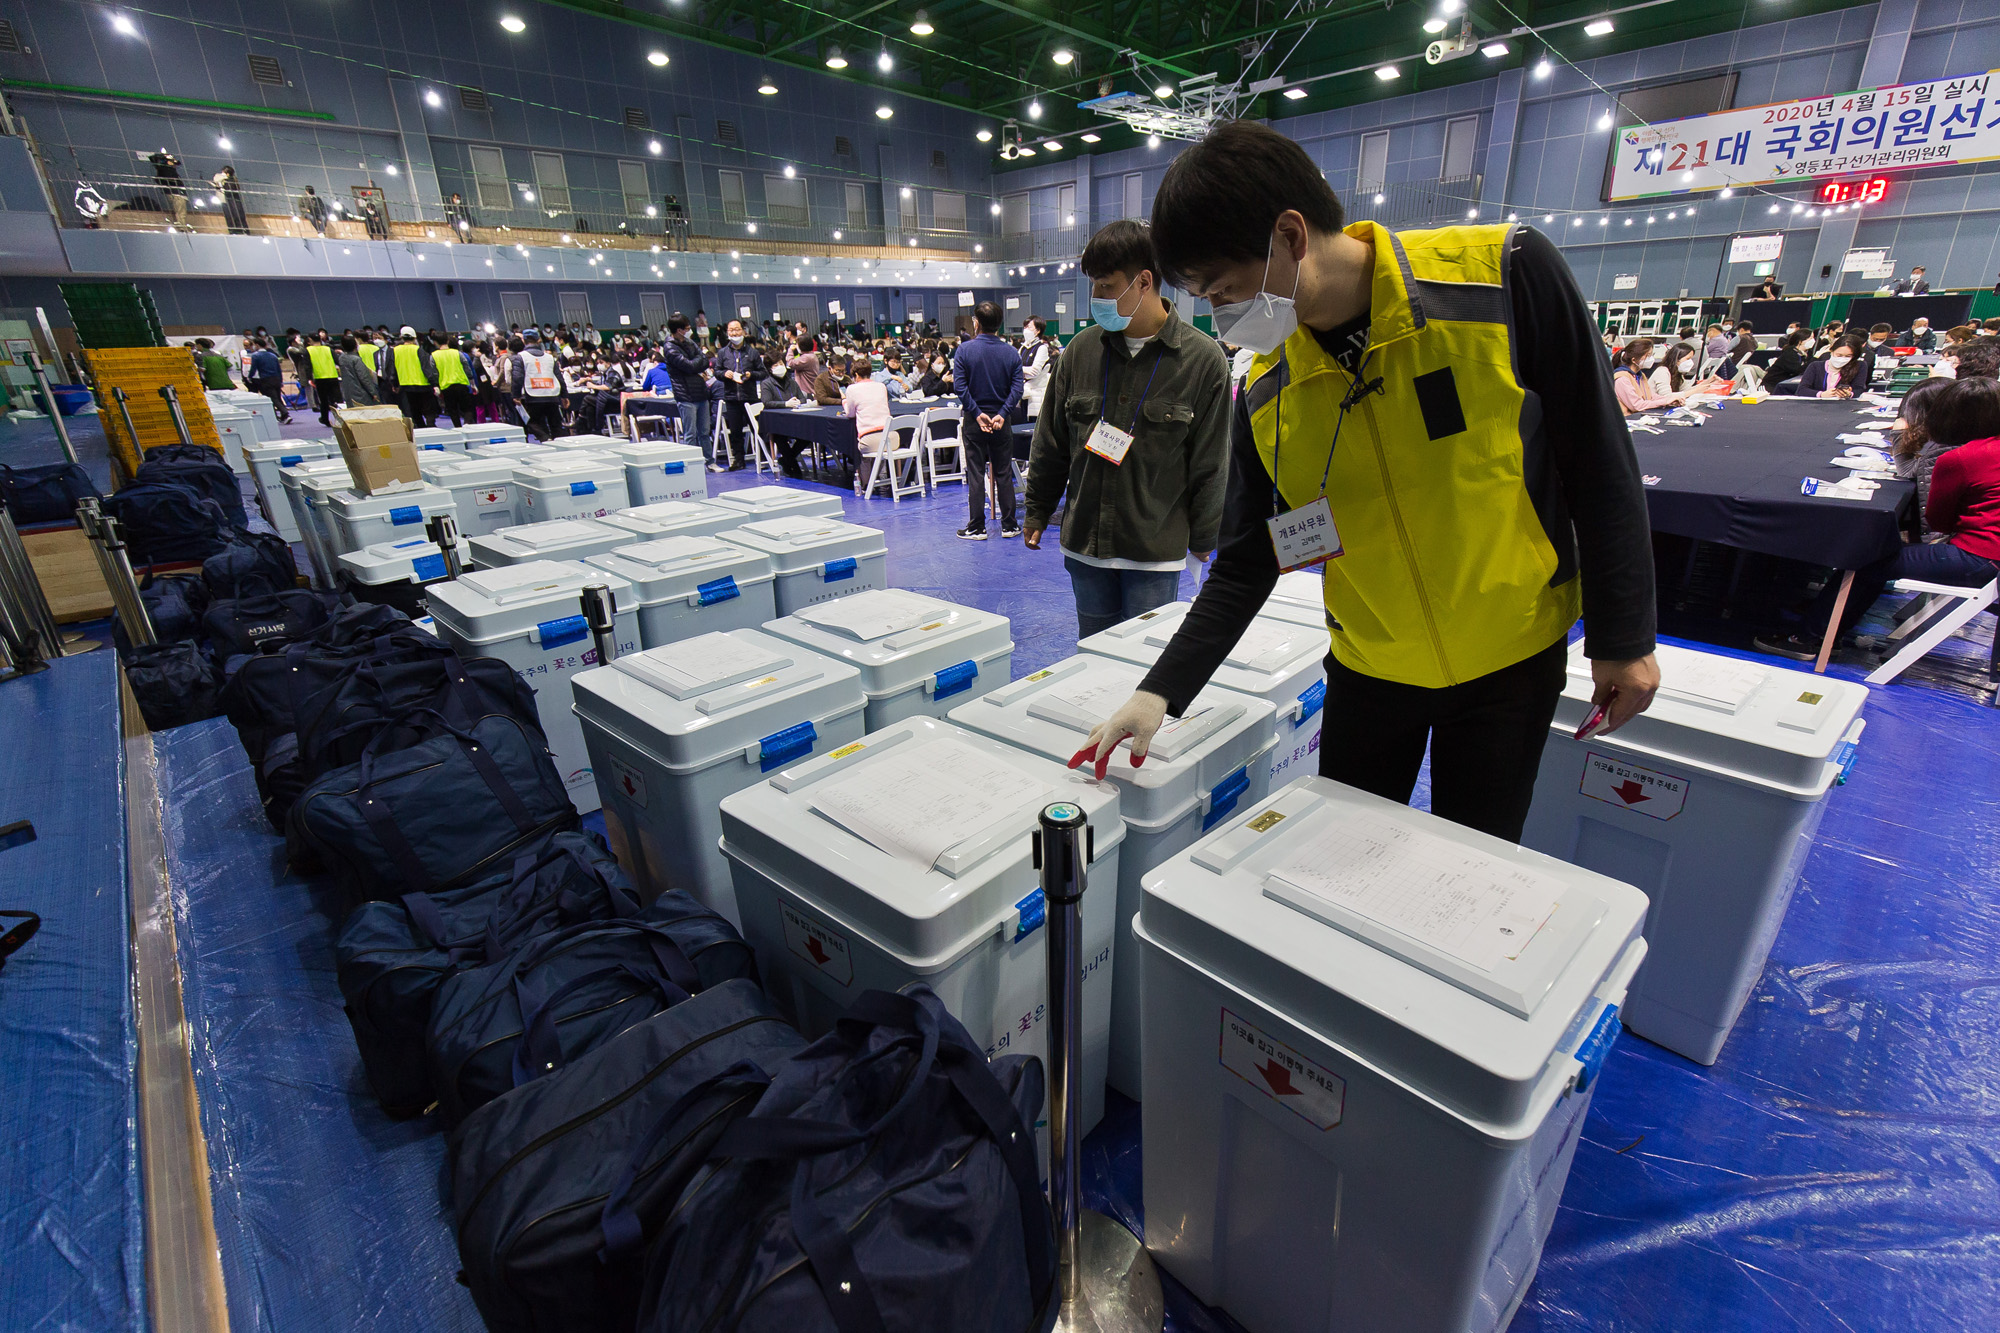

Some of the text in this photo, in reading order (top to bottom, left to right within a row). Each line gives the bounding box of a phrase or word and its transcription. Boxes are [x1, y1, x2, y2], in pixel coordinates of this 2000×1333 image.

[1763, 76, 1991, 124] 2020년 4월 15일 실시
[1633, 130, 1751, 175] 제21대
[1795, 145, 1952, 174] 영등포구선거관리위원회
[1824, 179, 1887, 203] 7:13
[1099, 429, 1126, 448] 개표사무원
[1278, 513, 1327, 540] 개표사무원
[553, 656, 576, 670] 꽃은
[1292, 743, 1306, 764] 꽃은
[1594, 761, 1679, 792] 이곳을 잡고 이동해 주세요
[1018, 1004, 1046, 1037] 꽃은
[1231, 1023, 1334, 1093] 이곳을 잡고 이동해 주세요
